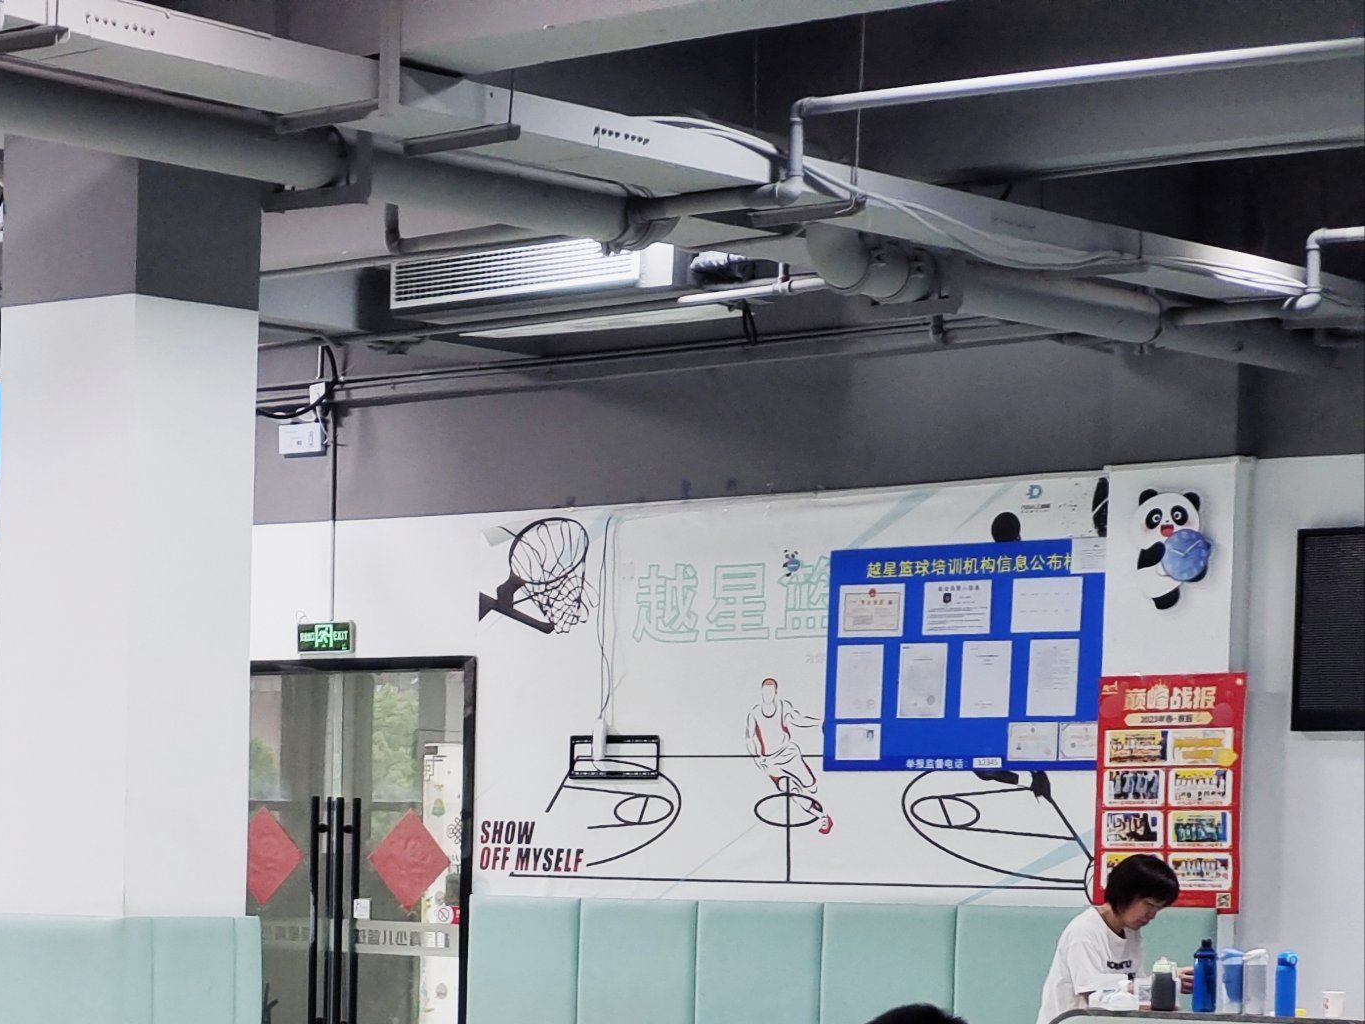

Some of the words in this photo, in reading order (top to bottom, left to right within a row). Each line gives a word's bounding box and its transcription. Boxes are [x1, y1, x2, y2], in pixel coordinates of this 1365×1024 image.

[333, 630, 348, 641] EXIT
[480, 820, 535, 845] SHOW
[480, 846, 510, 870] OFF
[515, 847, 584, 872] MYSELF
